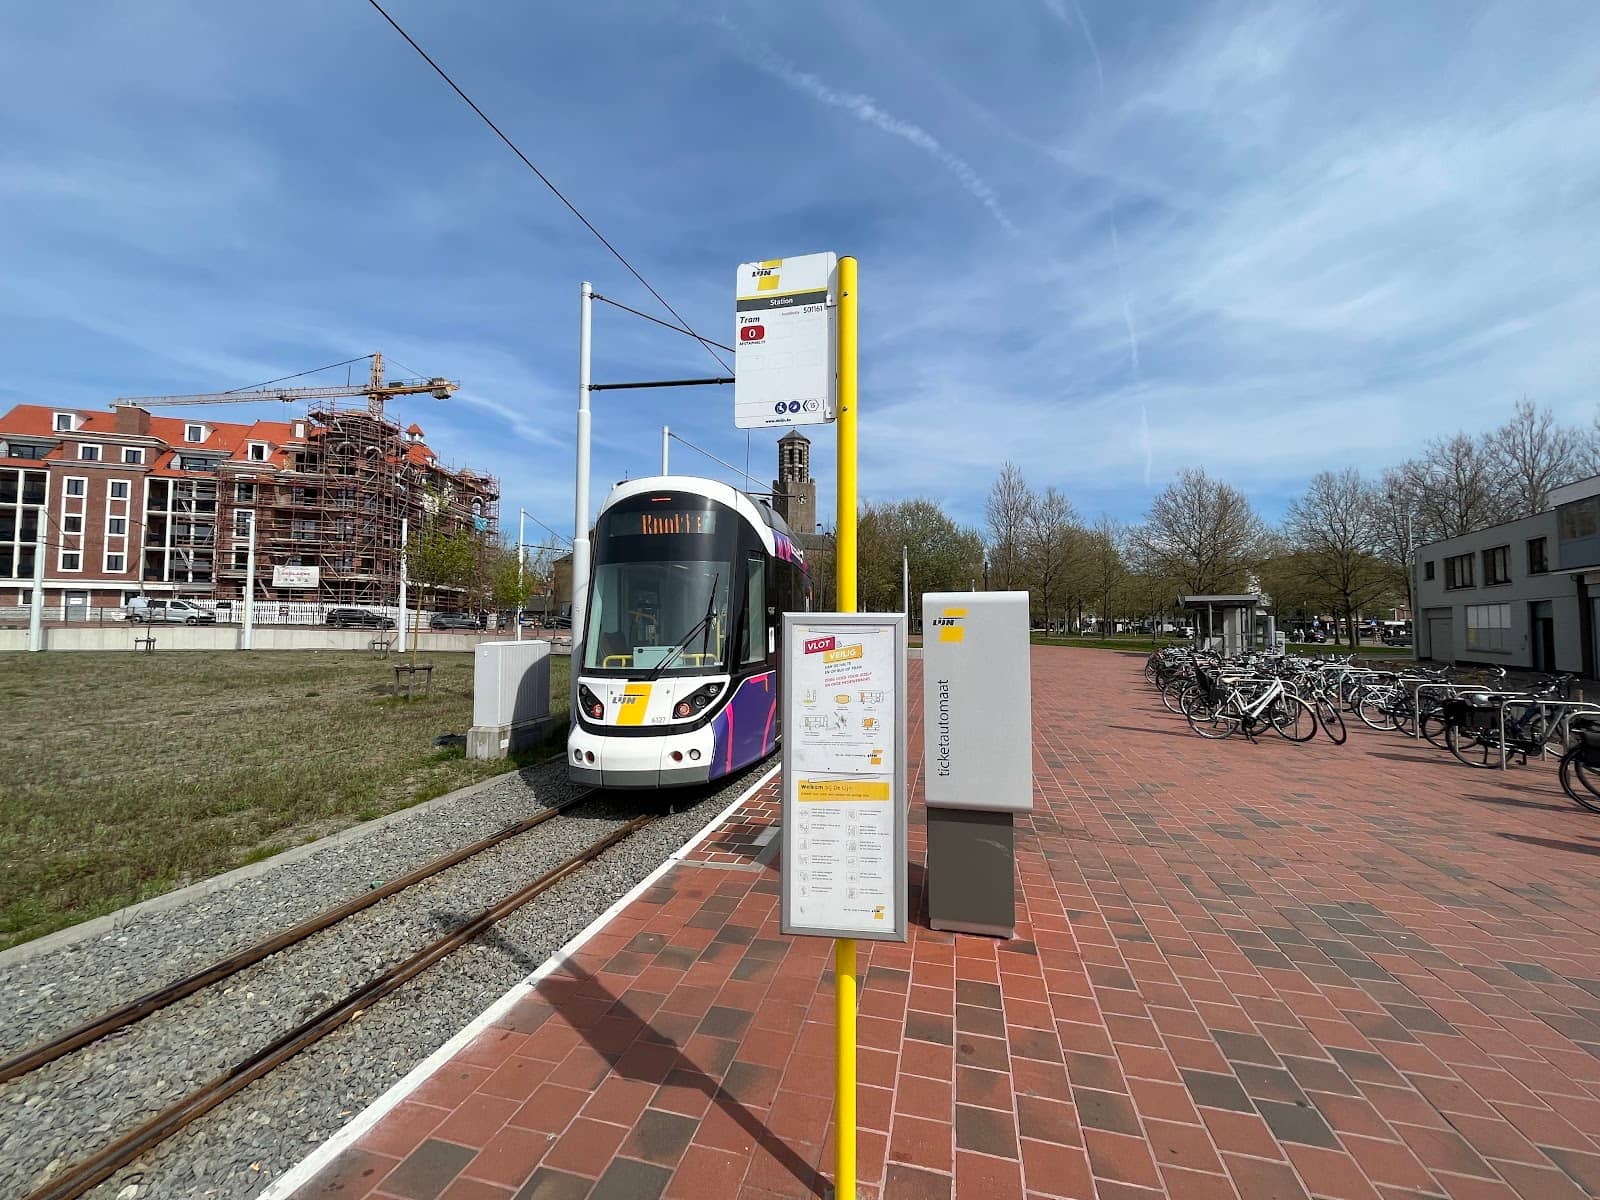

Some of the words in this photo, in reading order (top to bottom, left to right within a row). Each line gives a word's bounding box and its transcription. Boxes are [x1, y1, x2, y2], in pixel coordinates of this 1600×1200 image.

[769, 297, 794, 306] Station
[803, 305, 824, 314] 501161
[739, 316, 761, 324] Tram
[748, 328, 756, 338] 0
[807, 639, 831, 651] VLOT
[830, 649, 858, 660] VEILIG
[937, 679, 950, 777] ticketautomaat
[801, 783, 824, 791] Welkom
